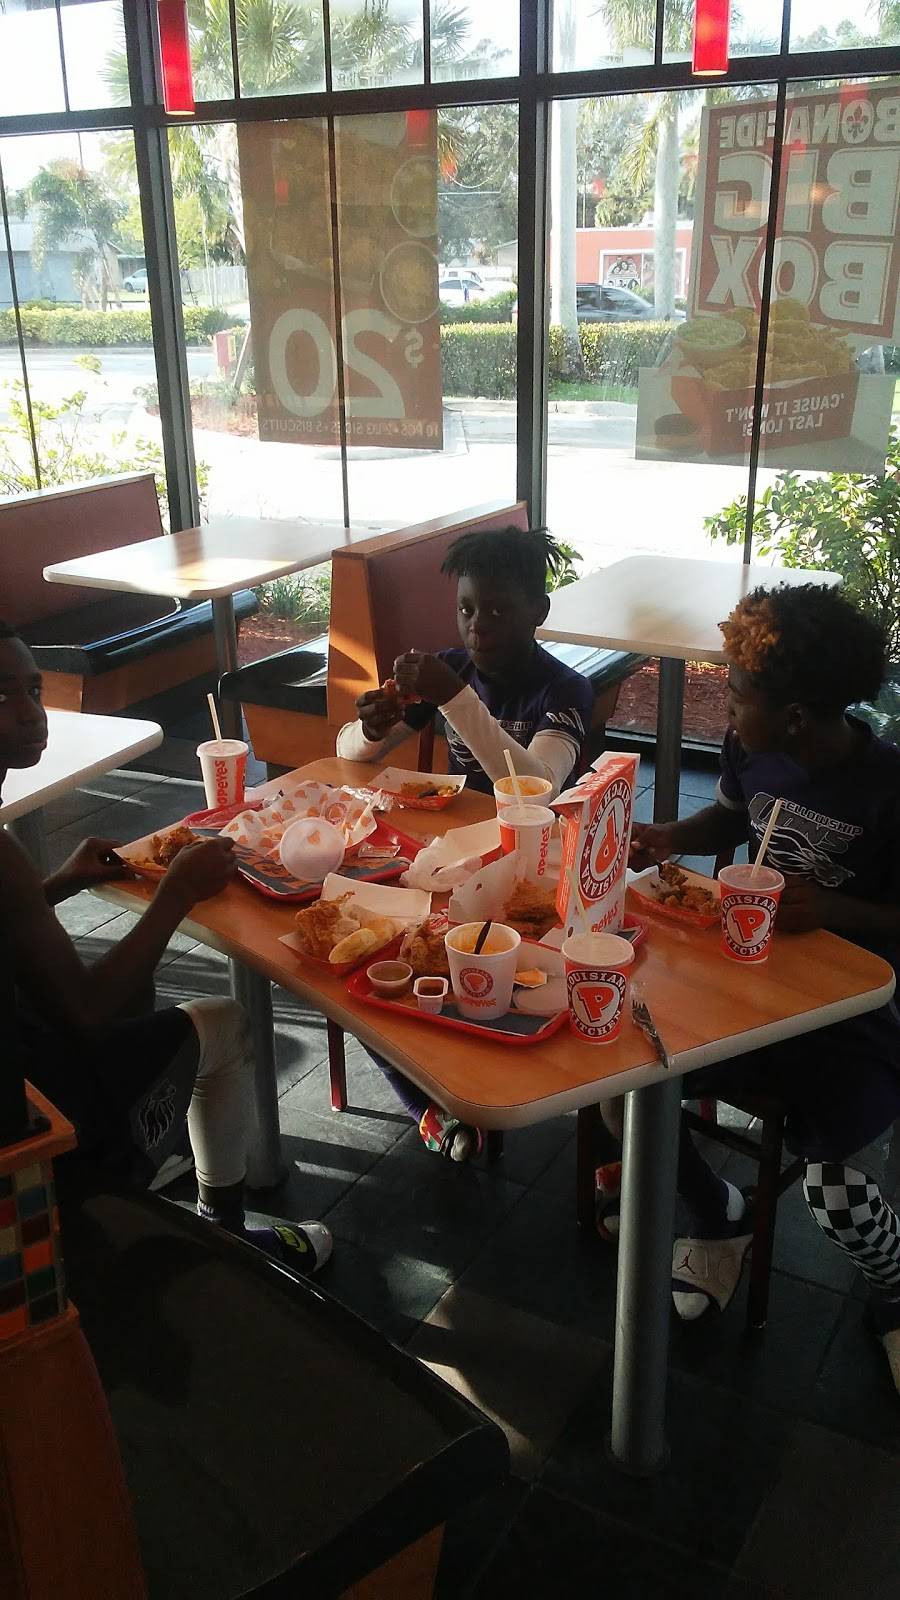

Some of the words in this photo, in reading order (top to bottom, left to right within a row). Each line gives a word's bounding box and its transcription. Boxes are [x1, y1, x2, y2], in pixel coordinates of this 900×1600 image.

[778, 796, 864, 837] FELLOWSHIP
[722, 895, 776, 919] LOUISIANA
[567, 971, 626, 995] LOUISIANA
